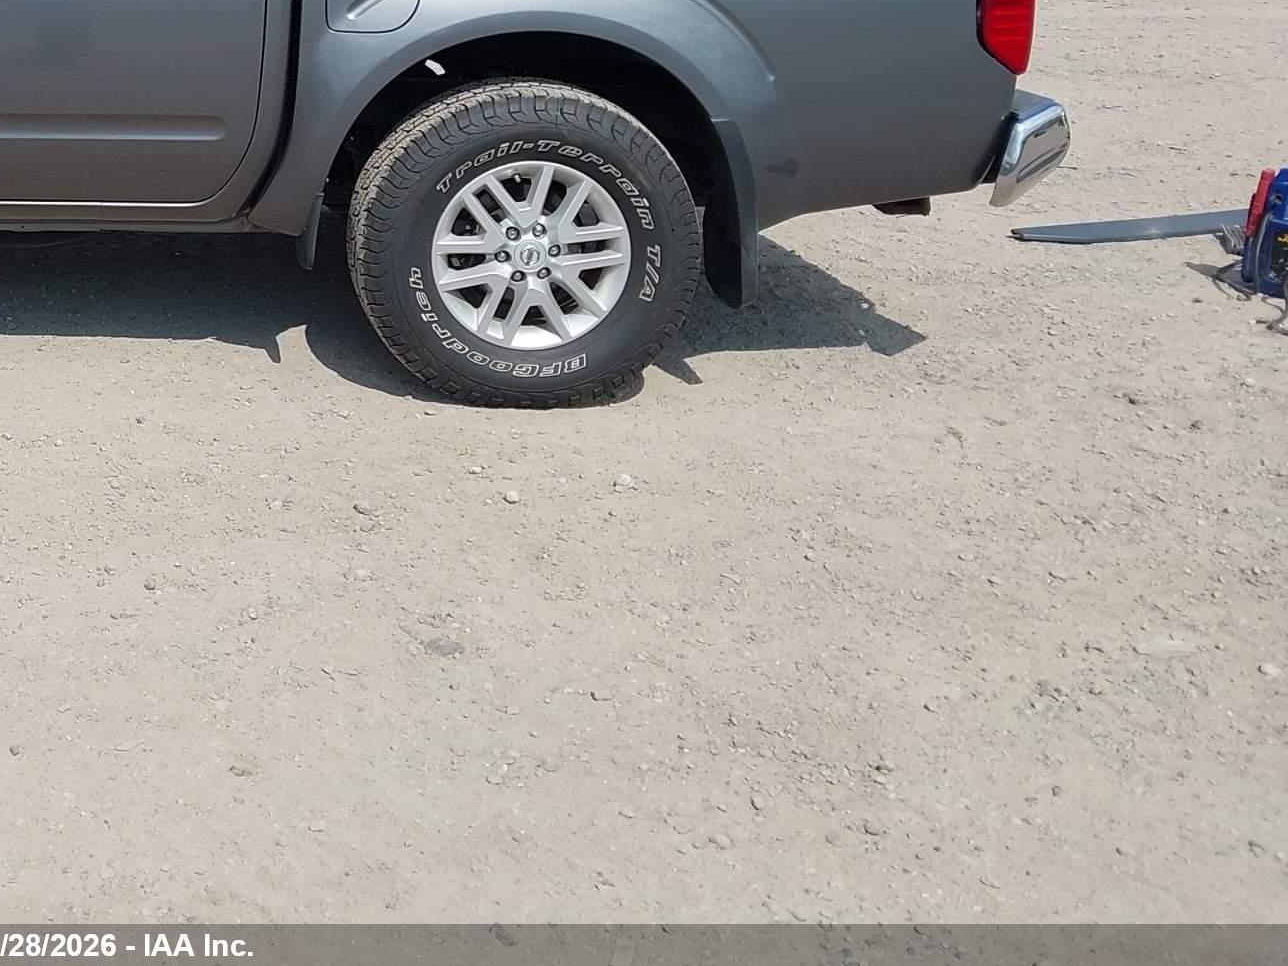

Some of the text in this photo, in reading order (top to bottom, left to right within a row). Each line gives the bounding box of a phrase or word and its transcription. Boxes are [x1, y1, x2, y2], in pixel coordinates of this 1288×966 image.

[435, 139, 662, 302] Trail-Terrain T/A
[408, 266, 588, 378] BFGoodrich
